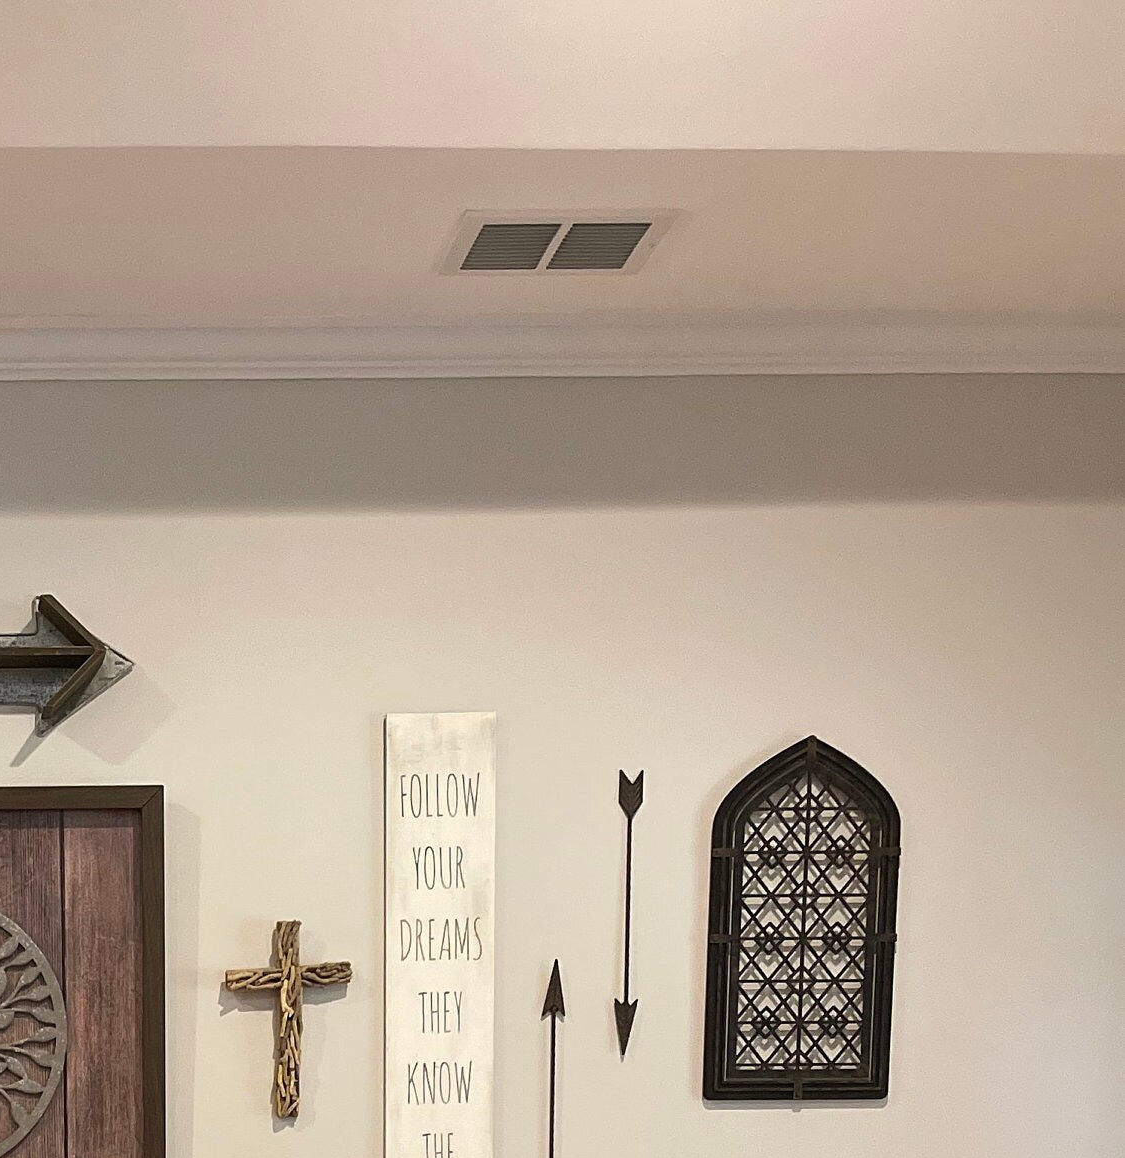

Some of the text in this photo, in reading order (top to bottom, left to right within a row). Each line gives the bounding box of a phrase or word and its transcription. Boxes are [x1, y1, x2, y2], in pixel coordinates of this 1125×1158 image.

[400, 771, 480, 819] FOLLOW
[412, 845, 466, 891] YOUR
[399, 916, 483, 962] DREAMS
[418, 990, 463, 1035] THEY
[407, 1060, 473, 1106] KNOW
